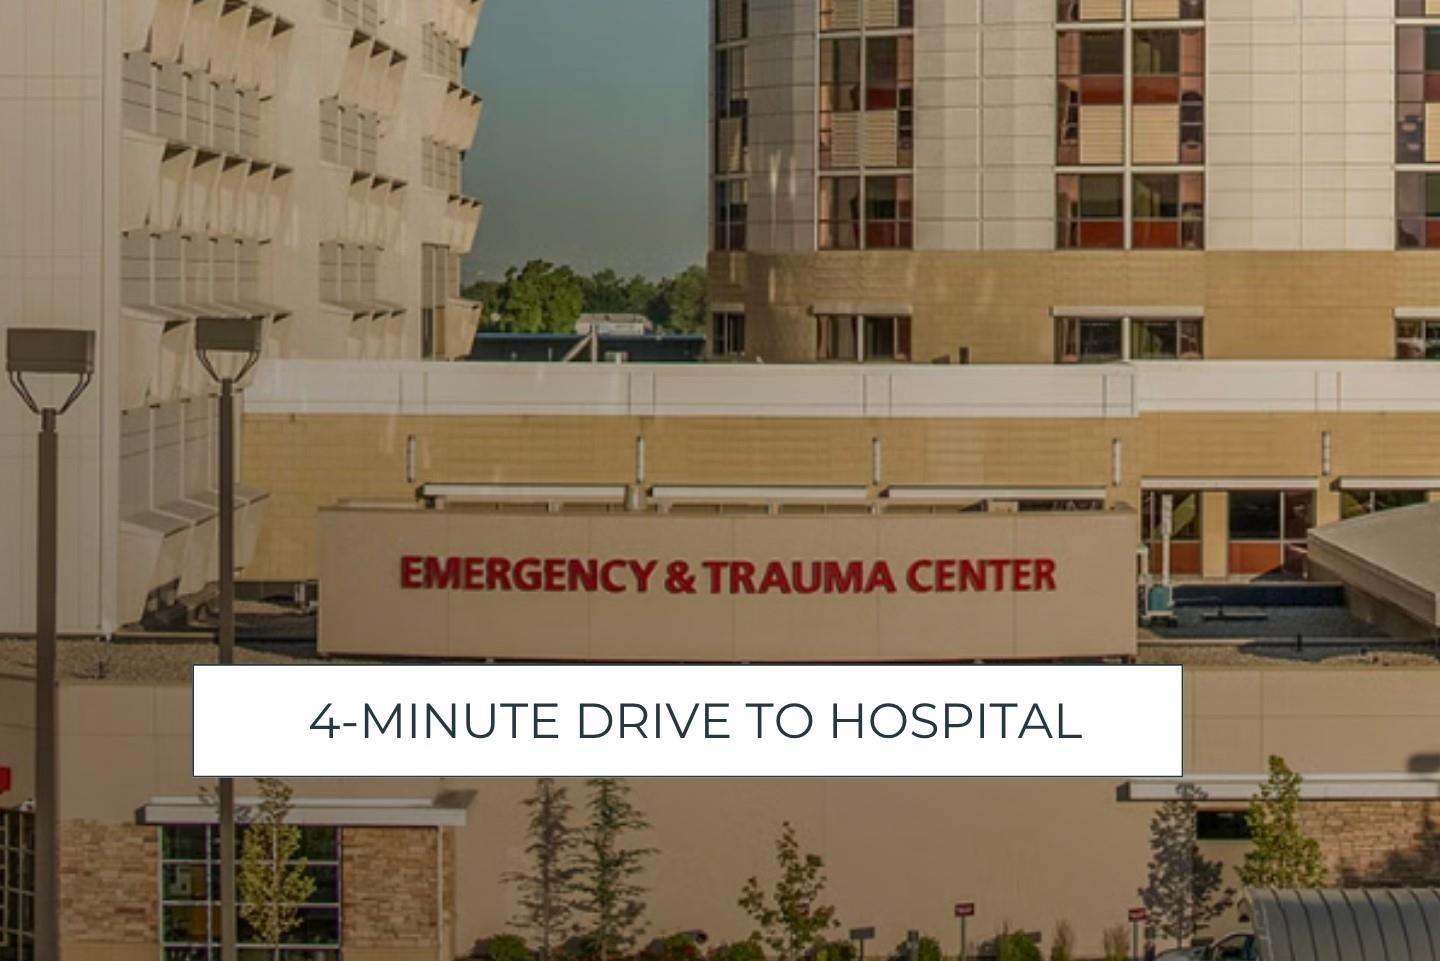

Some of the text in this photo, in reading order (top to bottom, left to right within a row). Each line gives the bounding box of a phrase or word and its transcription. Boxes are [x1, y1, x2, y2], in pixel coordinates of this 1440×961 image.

[400, 555, 1056, 595] EMERGENCY & TRAUMA CENTER
